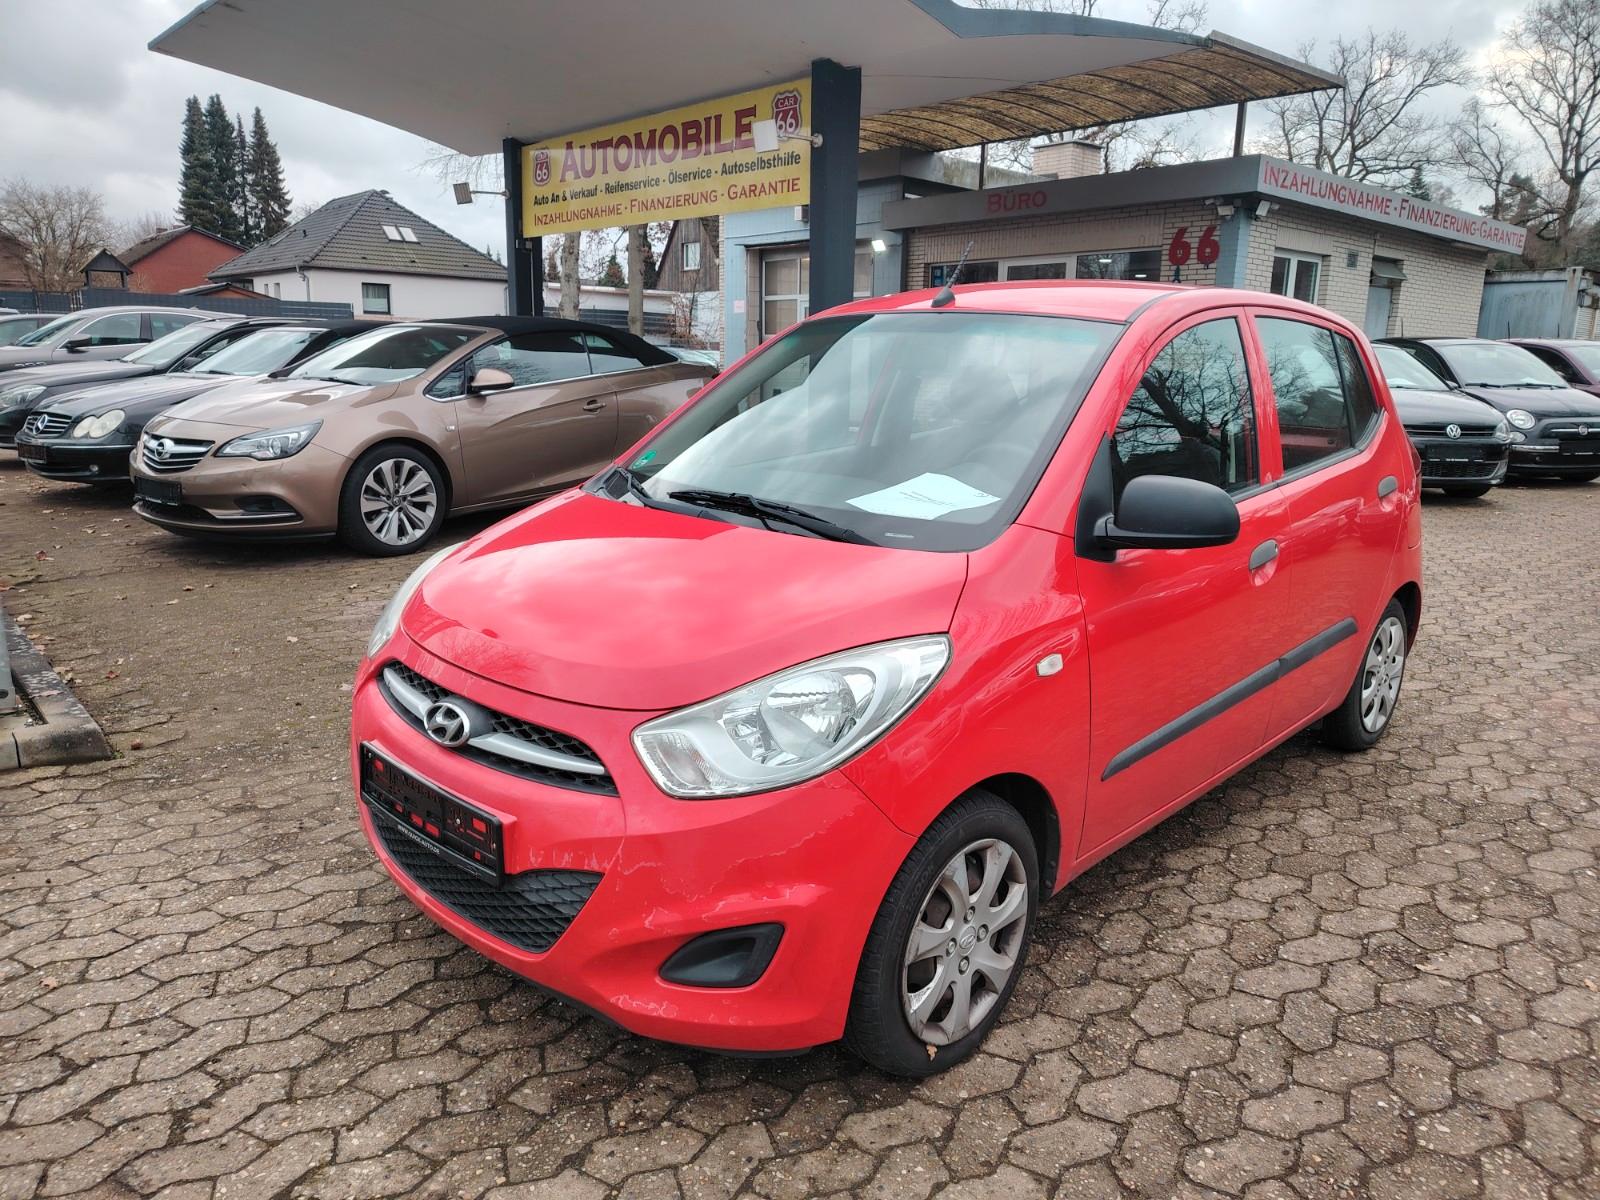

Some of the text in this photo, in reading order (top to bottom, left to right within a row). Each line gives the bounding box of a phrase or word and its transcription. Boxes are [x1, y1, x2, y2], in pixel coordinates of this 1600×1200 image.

[776, 110, 796, 134] 66
[778, 99, 795, 108] CAR
[560, 104, 756, 183] AUTOMOBILE
[533, 195, 549, 206] Auto
[550, 192, 560, 203] An
[562, 191, 567, 202] &
[570, 187, 598, 200] Verkauf
[605, 176, 660, 194] Reifenservice
[668, 167, 712, 184] Ölservice
[721, 150, 801, 176] Autoselbsthilfe
[536, 162, 548, 181] 66
[1264, 162, 1392, 215] INZAHLUNGNAHME
[534, 203, 622, 226] INZAHLUNGNAHME
[630, 190, 718, 213] FINANZIERUNG
[727, 177, 801, 200] GARANTIE
[986, 190, 1047, 214] BÜRO
[1168, 226, 1220, 266] 66
